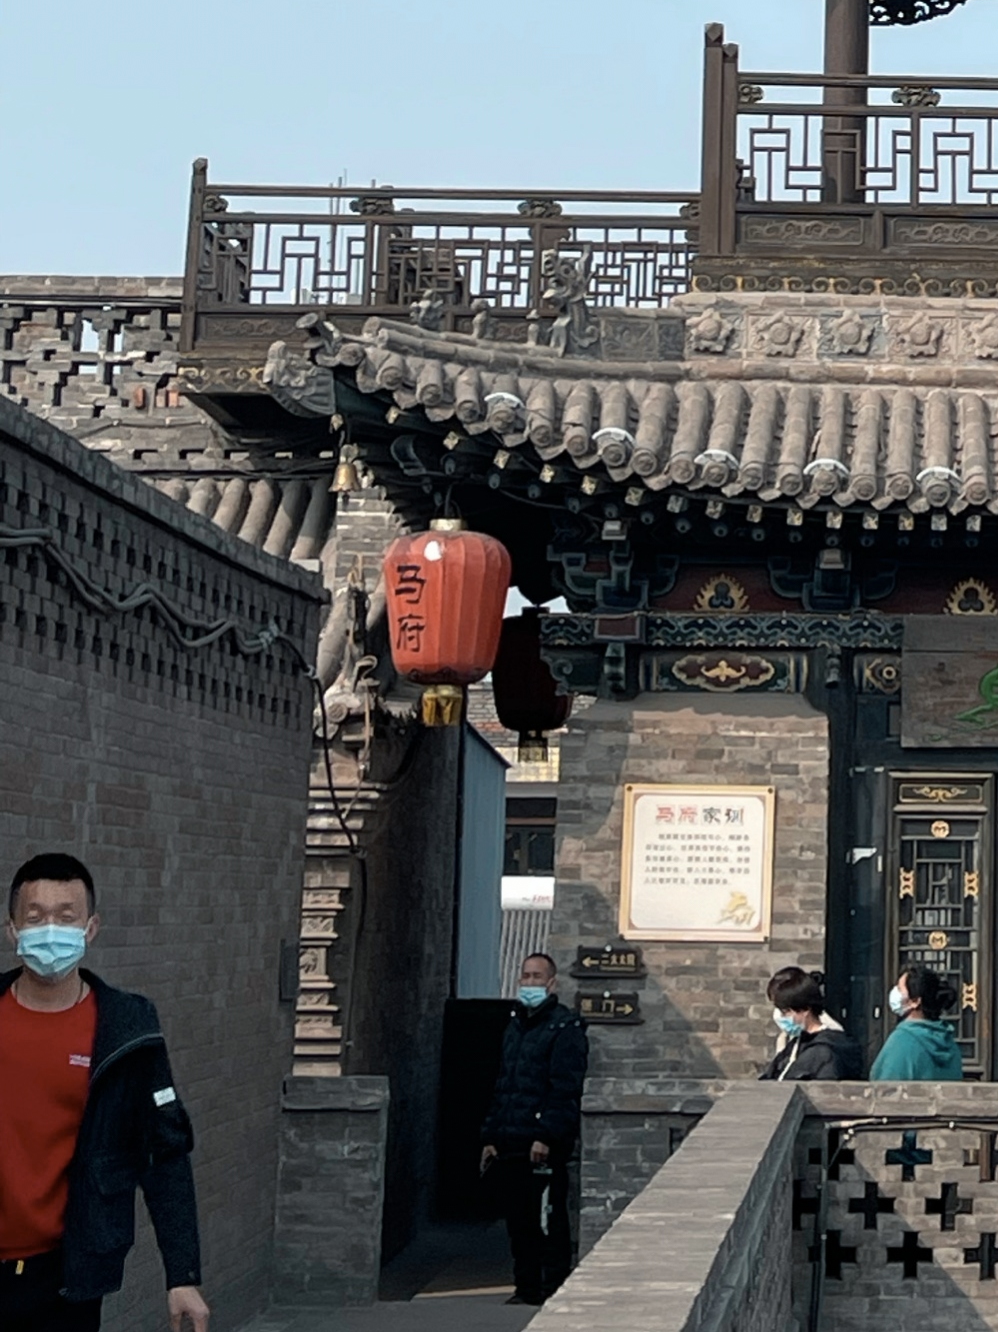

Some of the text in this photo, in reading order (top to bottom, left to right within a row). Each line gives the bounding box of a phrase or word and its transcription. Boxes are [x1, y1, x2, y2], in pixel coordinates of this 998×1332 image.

[394, 564, 427, 653] 马府
[655, 806, 744, 826] 马府家训
